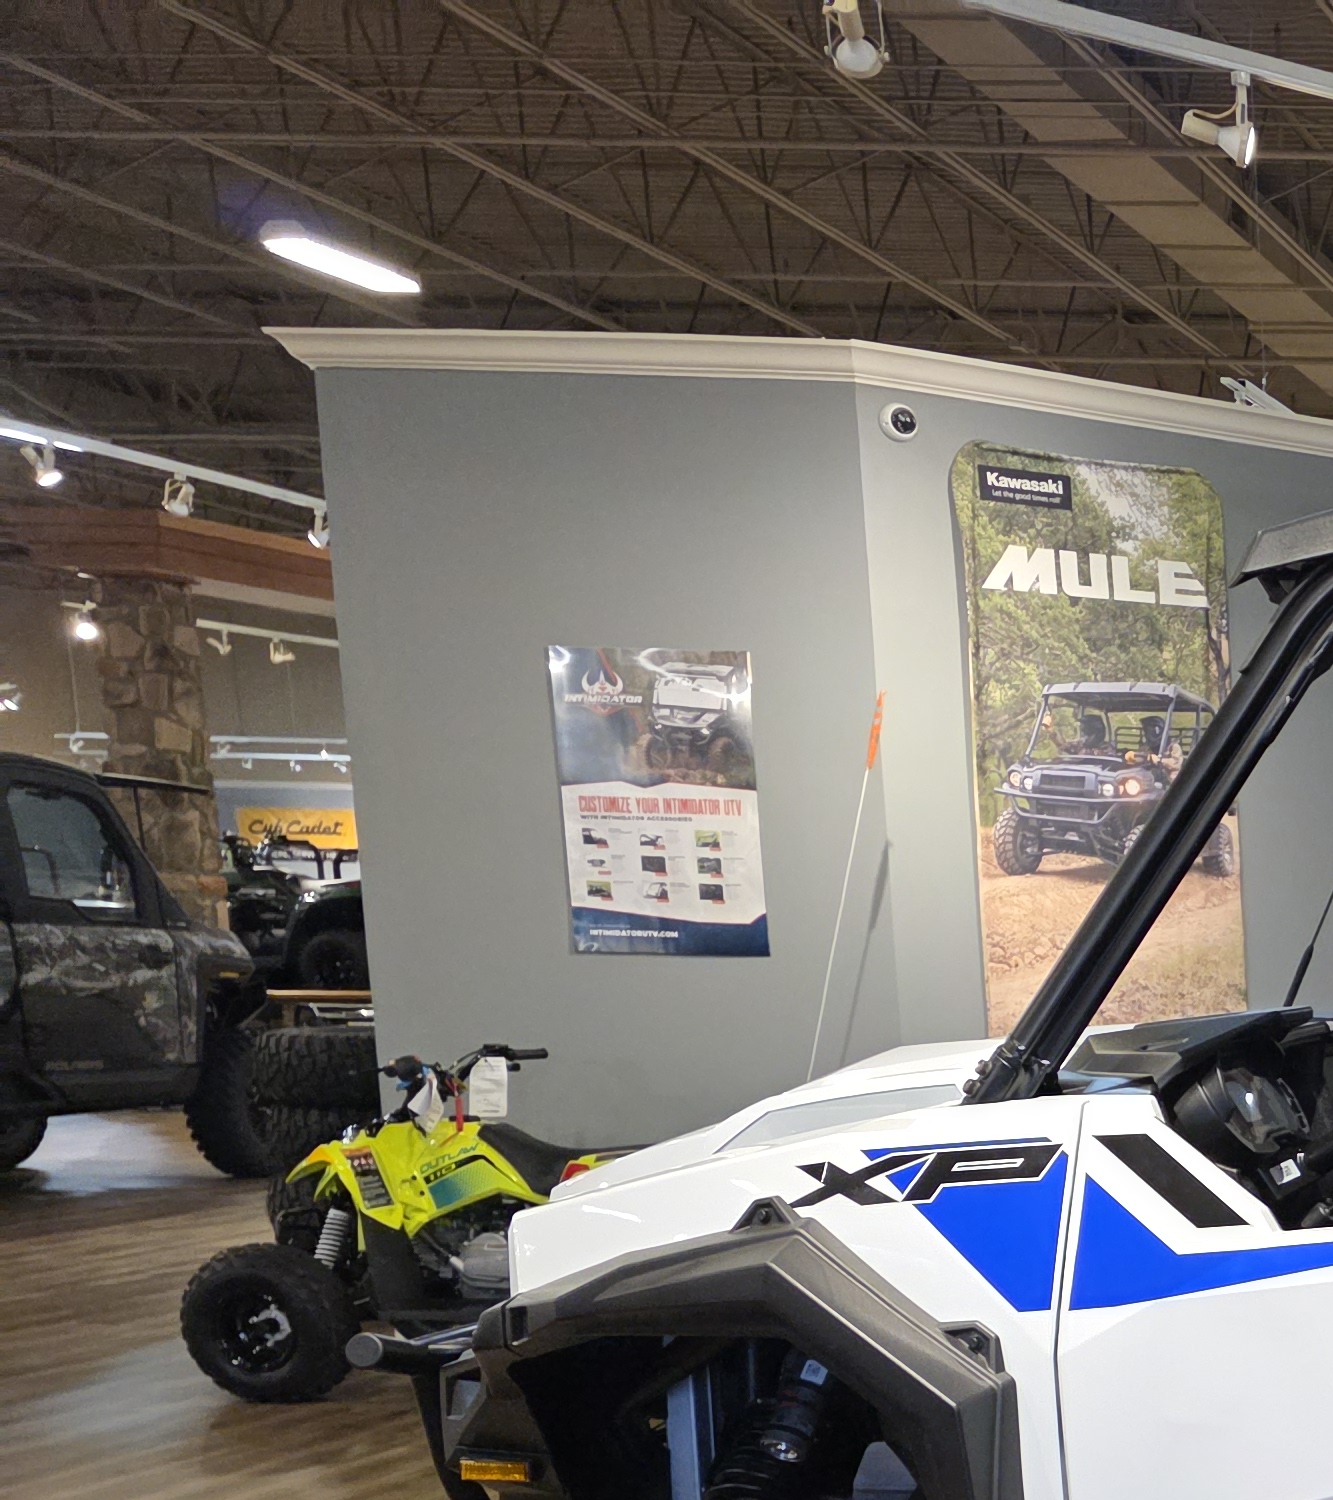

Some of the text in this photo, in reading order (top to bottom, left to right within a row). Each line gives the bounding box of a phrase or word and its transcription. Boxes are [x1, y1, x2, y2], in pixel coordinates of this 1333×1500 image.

[986, 471, 1063, 494] Kawasaki
[982, 545, 1210, 607] MULE
[564, 694, 642, 704] INTIMIDATOR
[578, 795, 742, 816] CUSTOMIZE YOUR INTIMIDATOR UTV
[286, 820, 343, 835] Cadet
[788, 1143, 1064, 1208] XP
